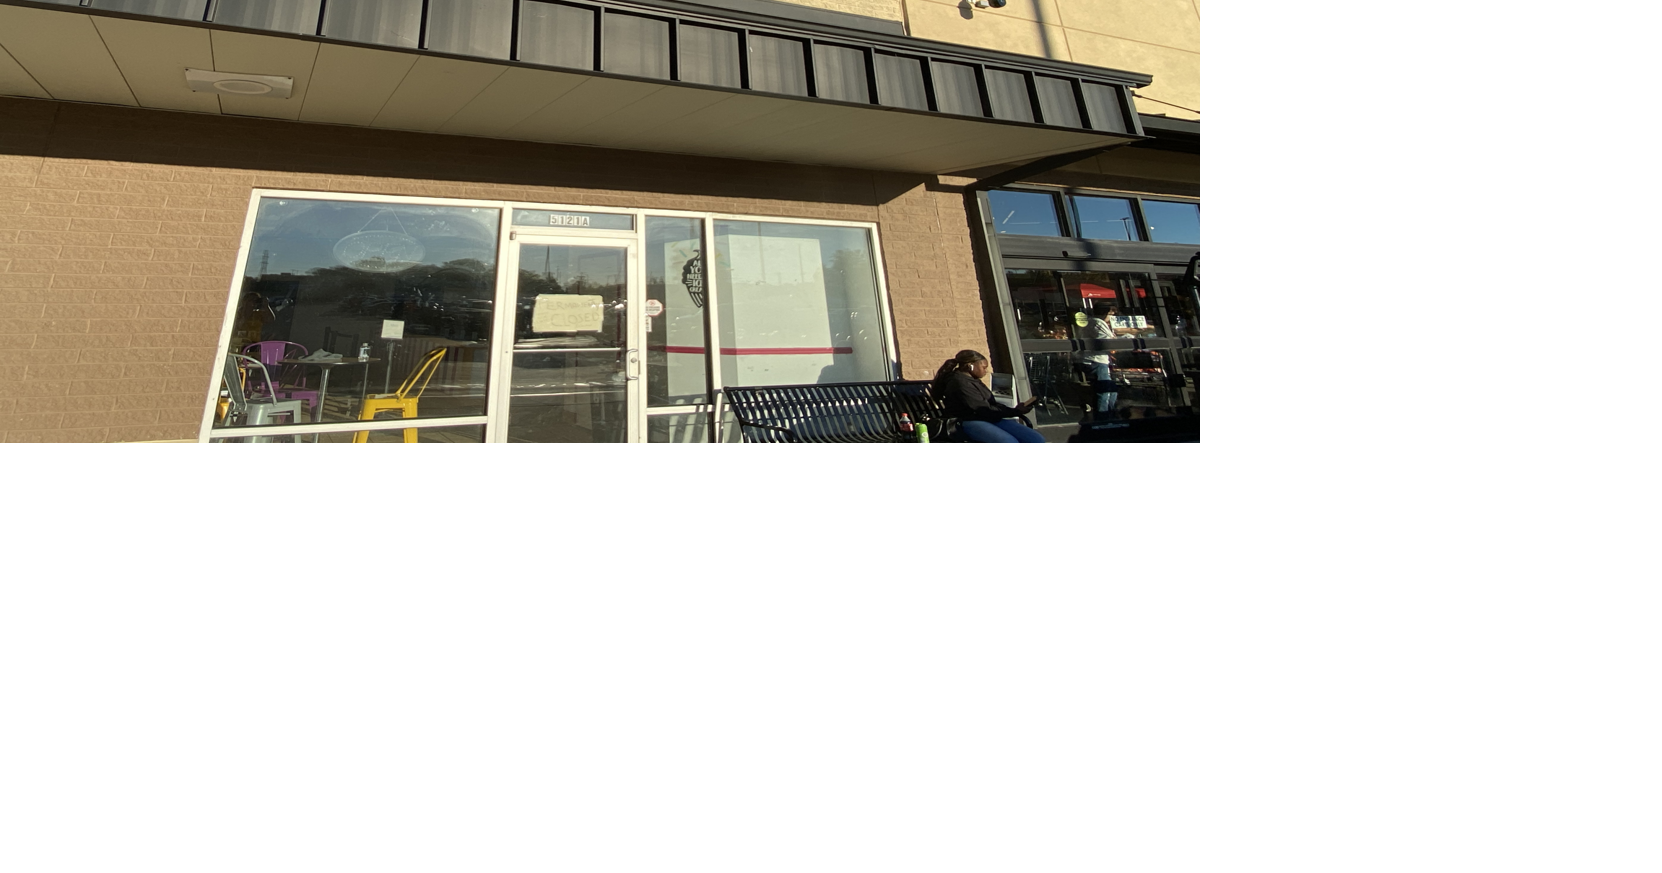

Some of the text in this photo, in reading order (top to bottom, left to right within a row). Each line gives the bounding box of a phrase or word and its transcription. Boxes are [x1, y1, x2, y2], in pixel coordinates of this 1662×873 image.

[551, 215, 589, 226] 5121A
[690, 266, 702, 274] YO
[551, 311, 600, 327] CLOSED
